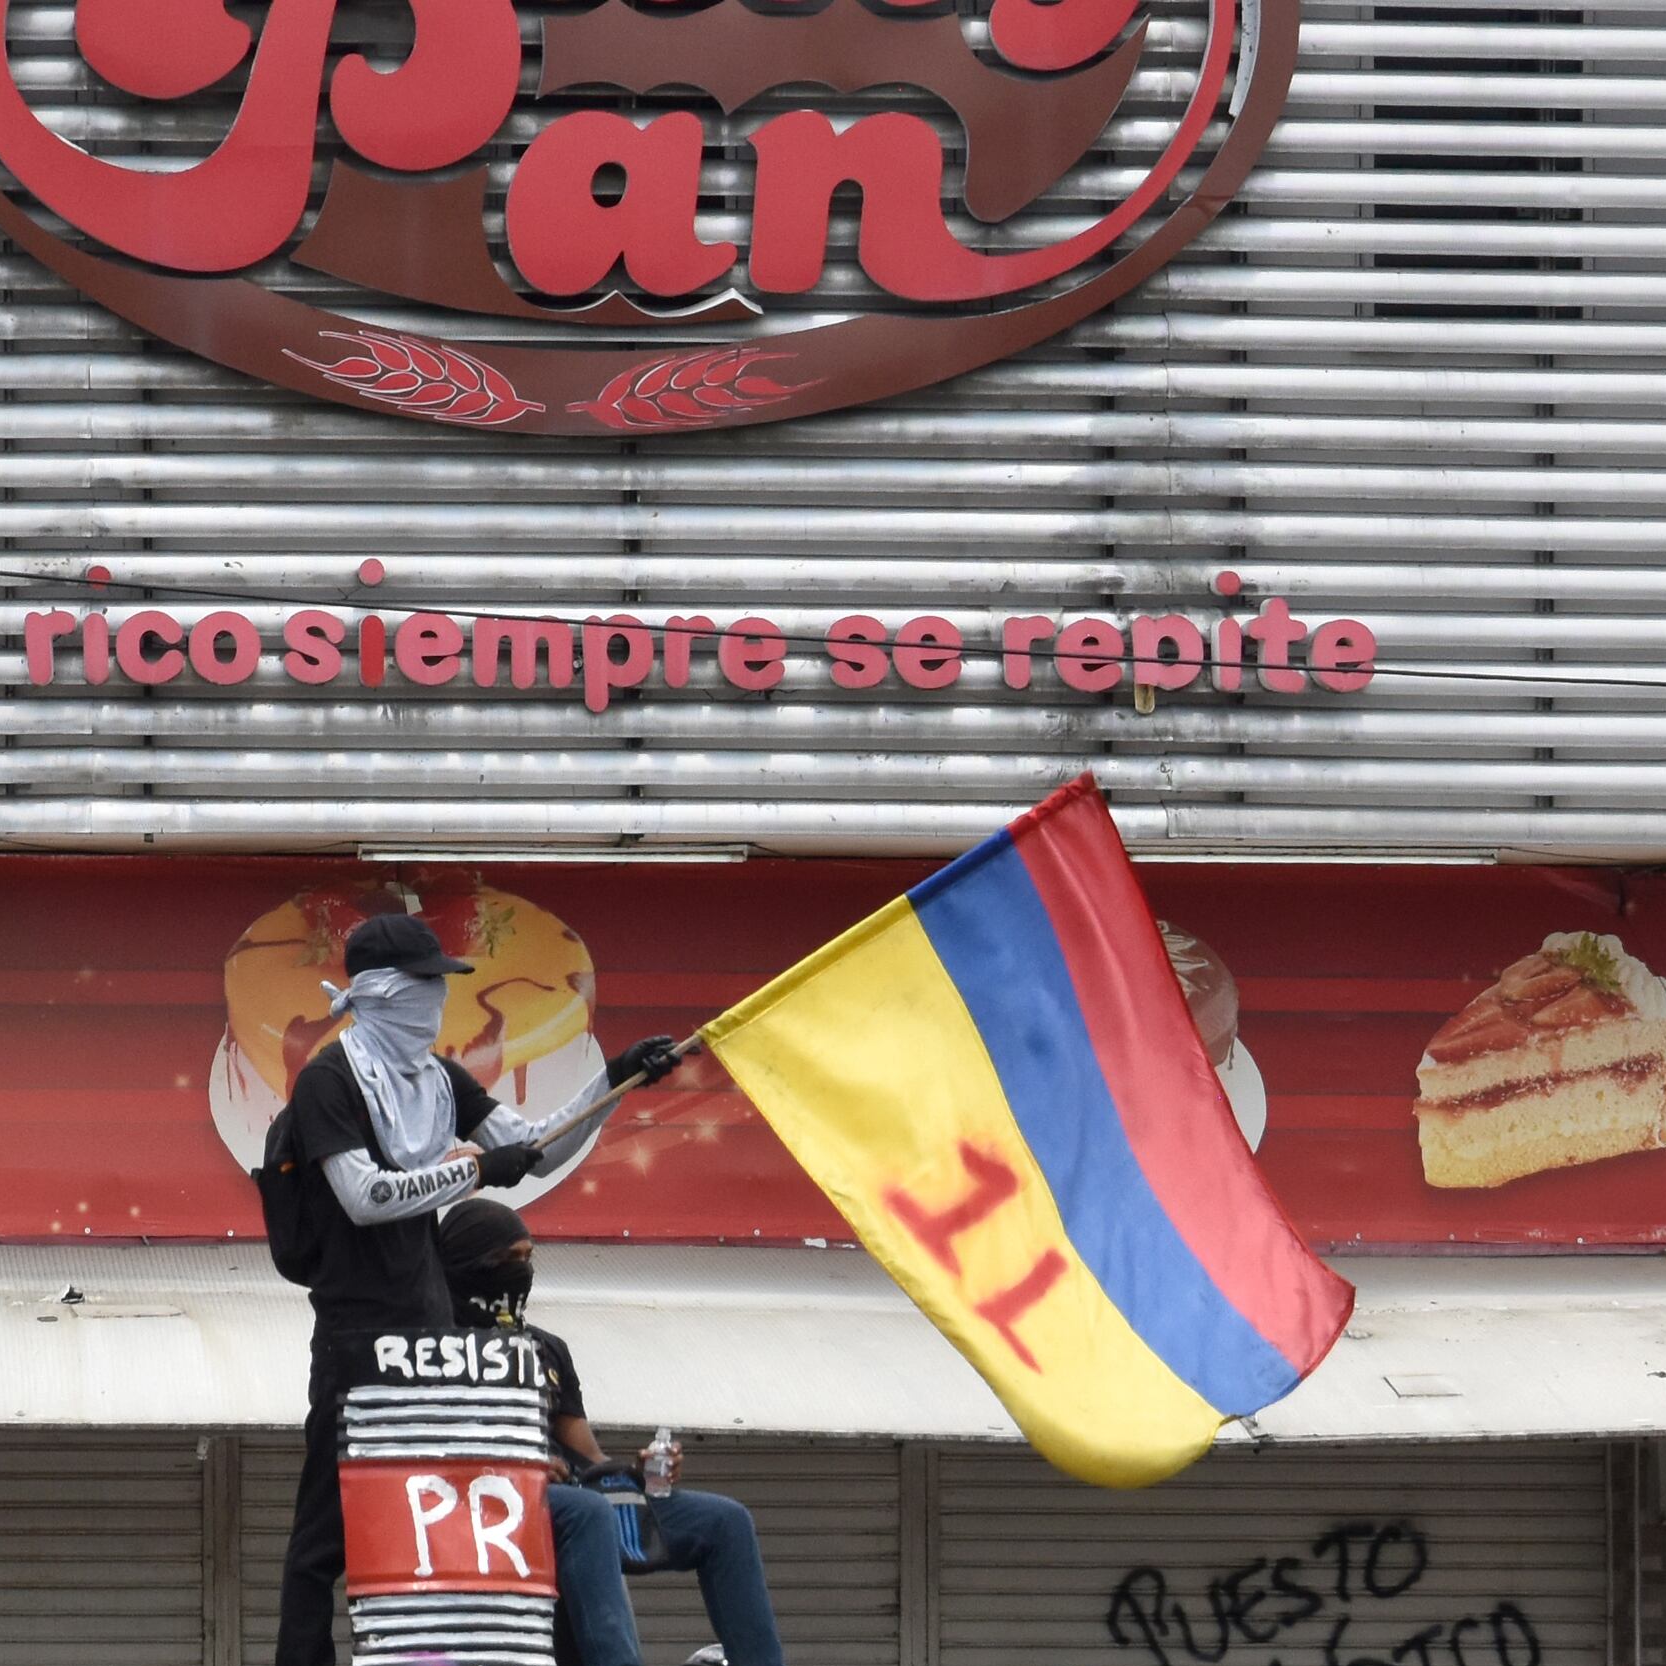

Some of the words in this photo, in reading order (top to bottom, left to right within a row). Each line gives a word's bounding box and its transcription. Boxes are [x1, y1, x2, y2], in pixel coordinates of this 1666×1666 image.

[25, 564, 260, 687] rico
[284, 558, 786, 713] siempre
[825, 608, 962, 691] se
[1003, 570, 1377, 715] repite
[395, 1161, 478, 1201] YAMAHA
[405, 1475, 531, 1578] PR
